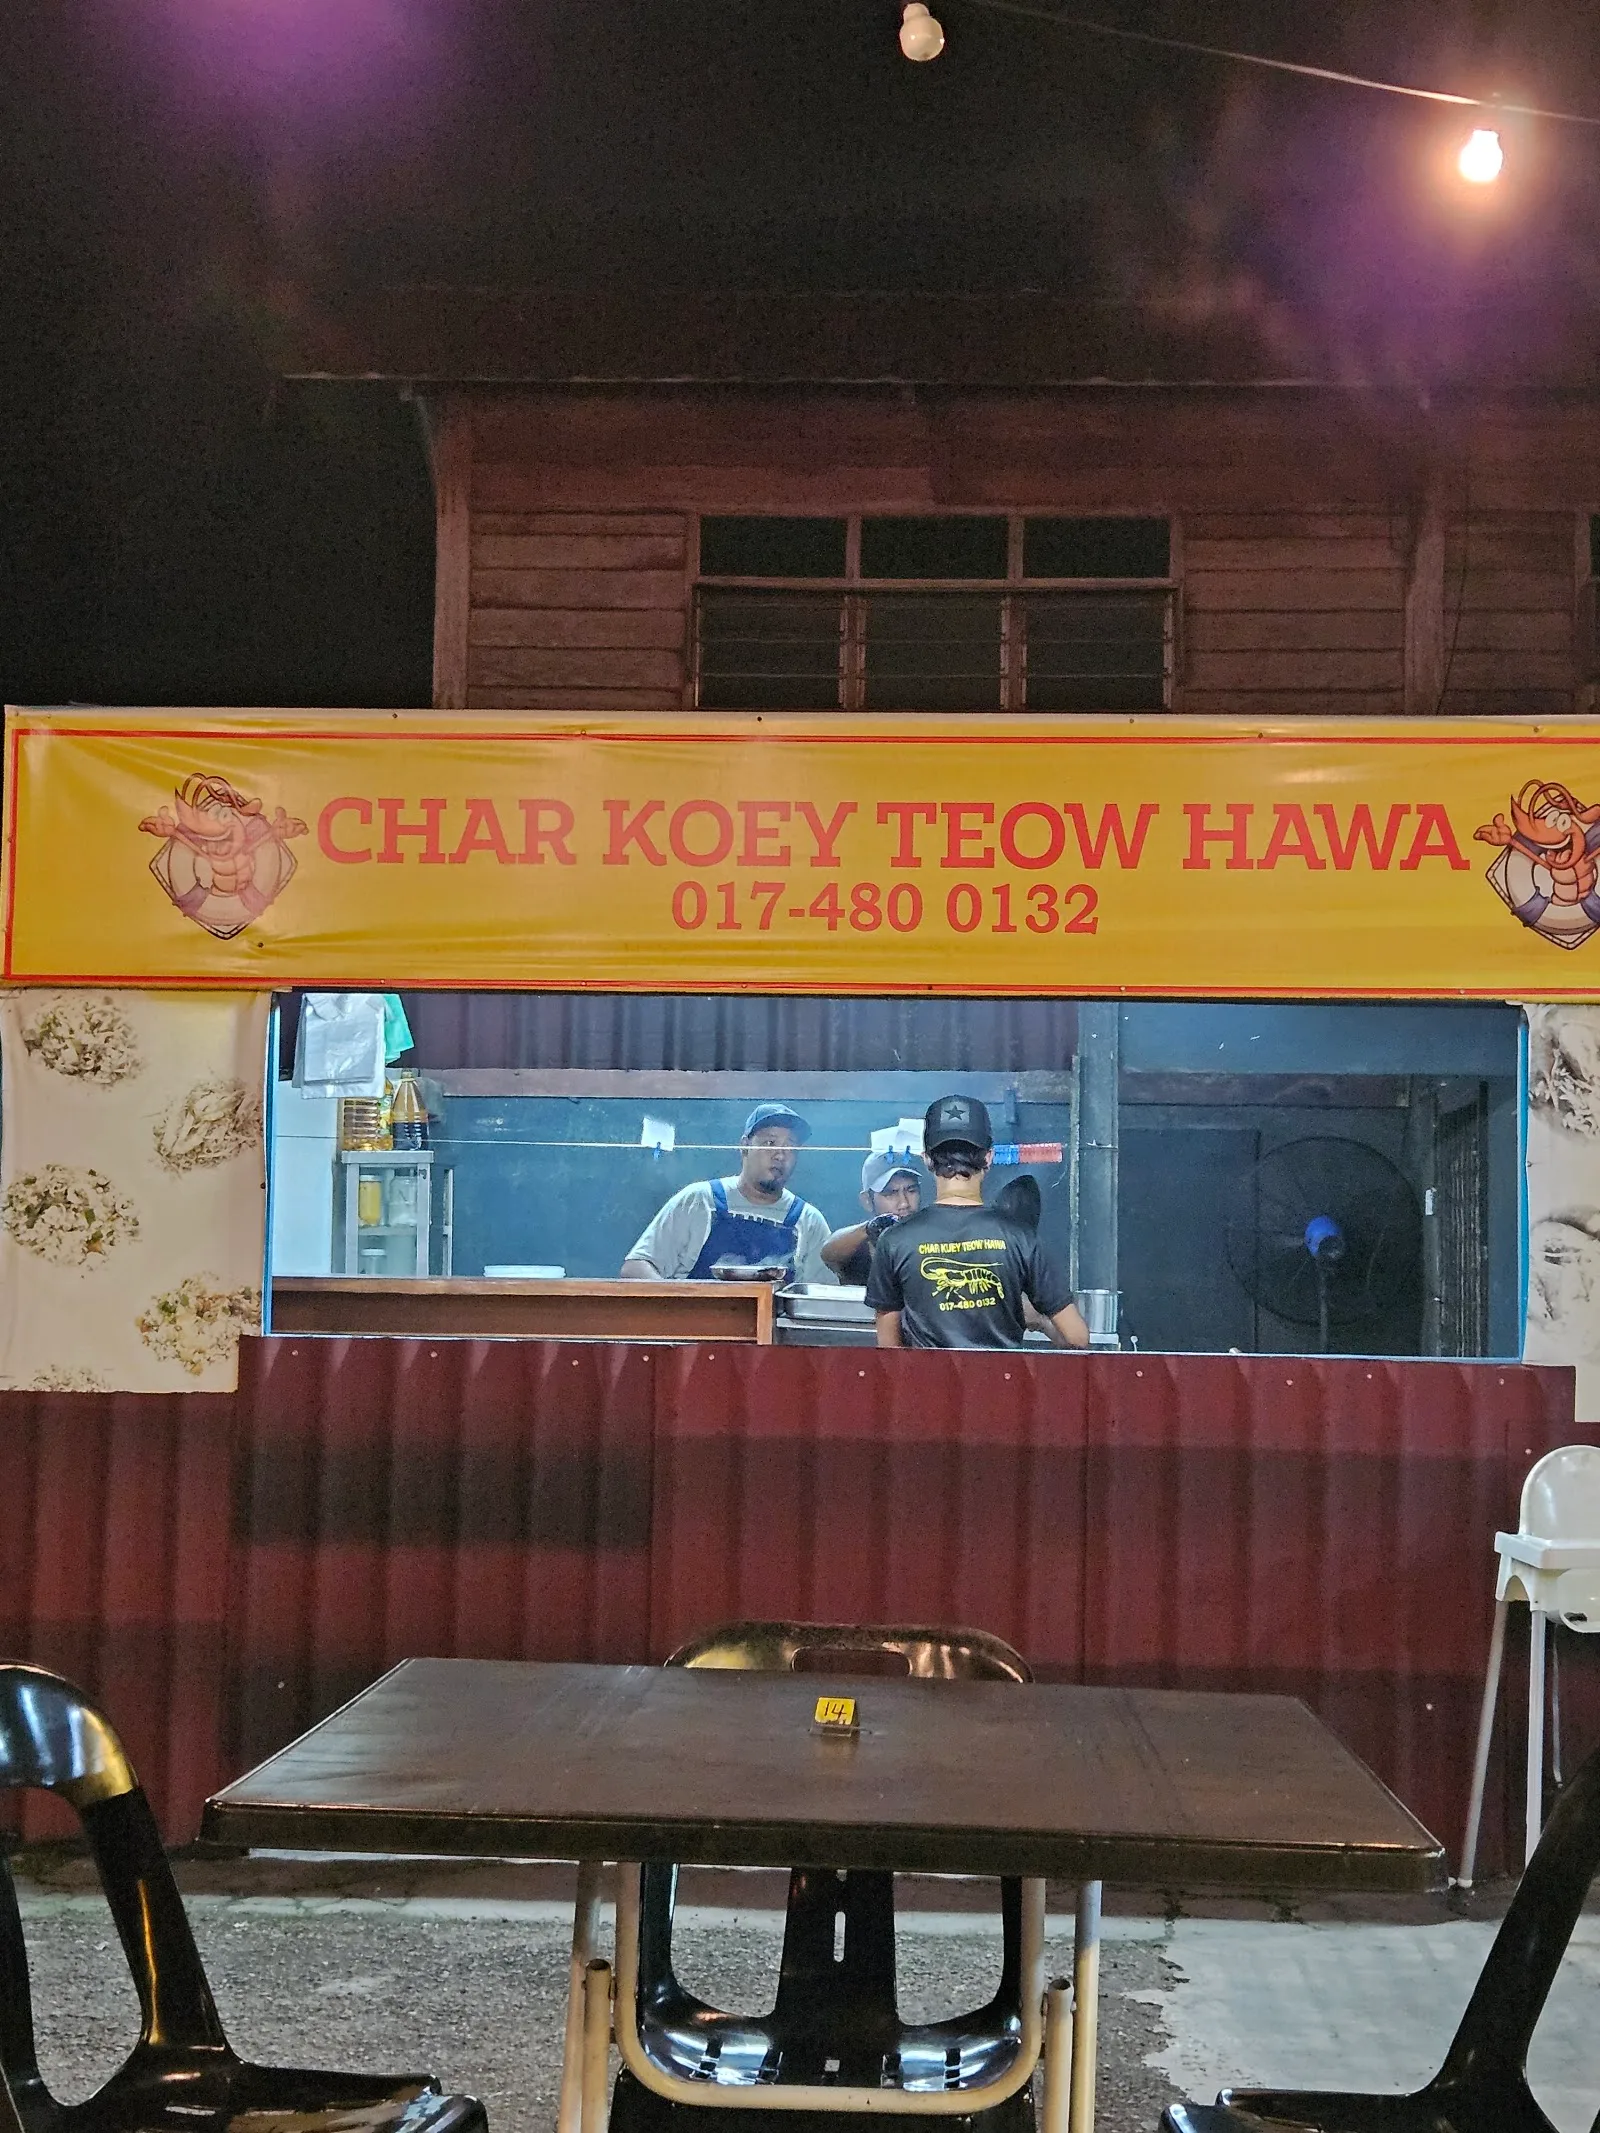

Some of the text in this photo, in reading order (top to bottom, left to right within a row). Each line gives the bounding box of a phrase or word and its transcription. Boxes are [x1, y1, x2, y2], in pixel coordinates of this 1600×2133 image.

[317, 797, 1472, 872] CHAR KOEY TEOW HAWA
[672, 881, 1099, 936] 017-480 0132
[919, 1243, 940, 1254] CHAR
[962, 1240, 983, 1251] TEOW
[984, 1239, 1006, 1250] HAWA
[939, 1297, 996, 1311] 017-480 0132
[824, 1701, 847, 1719] 14
